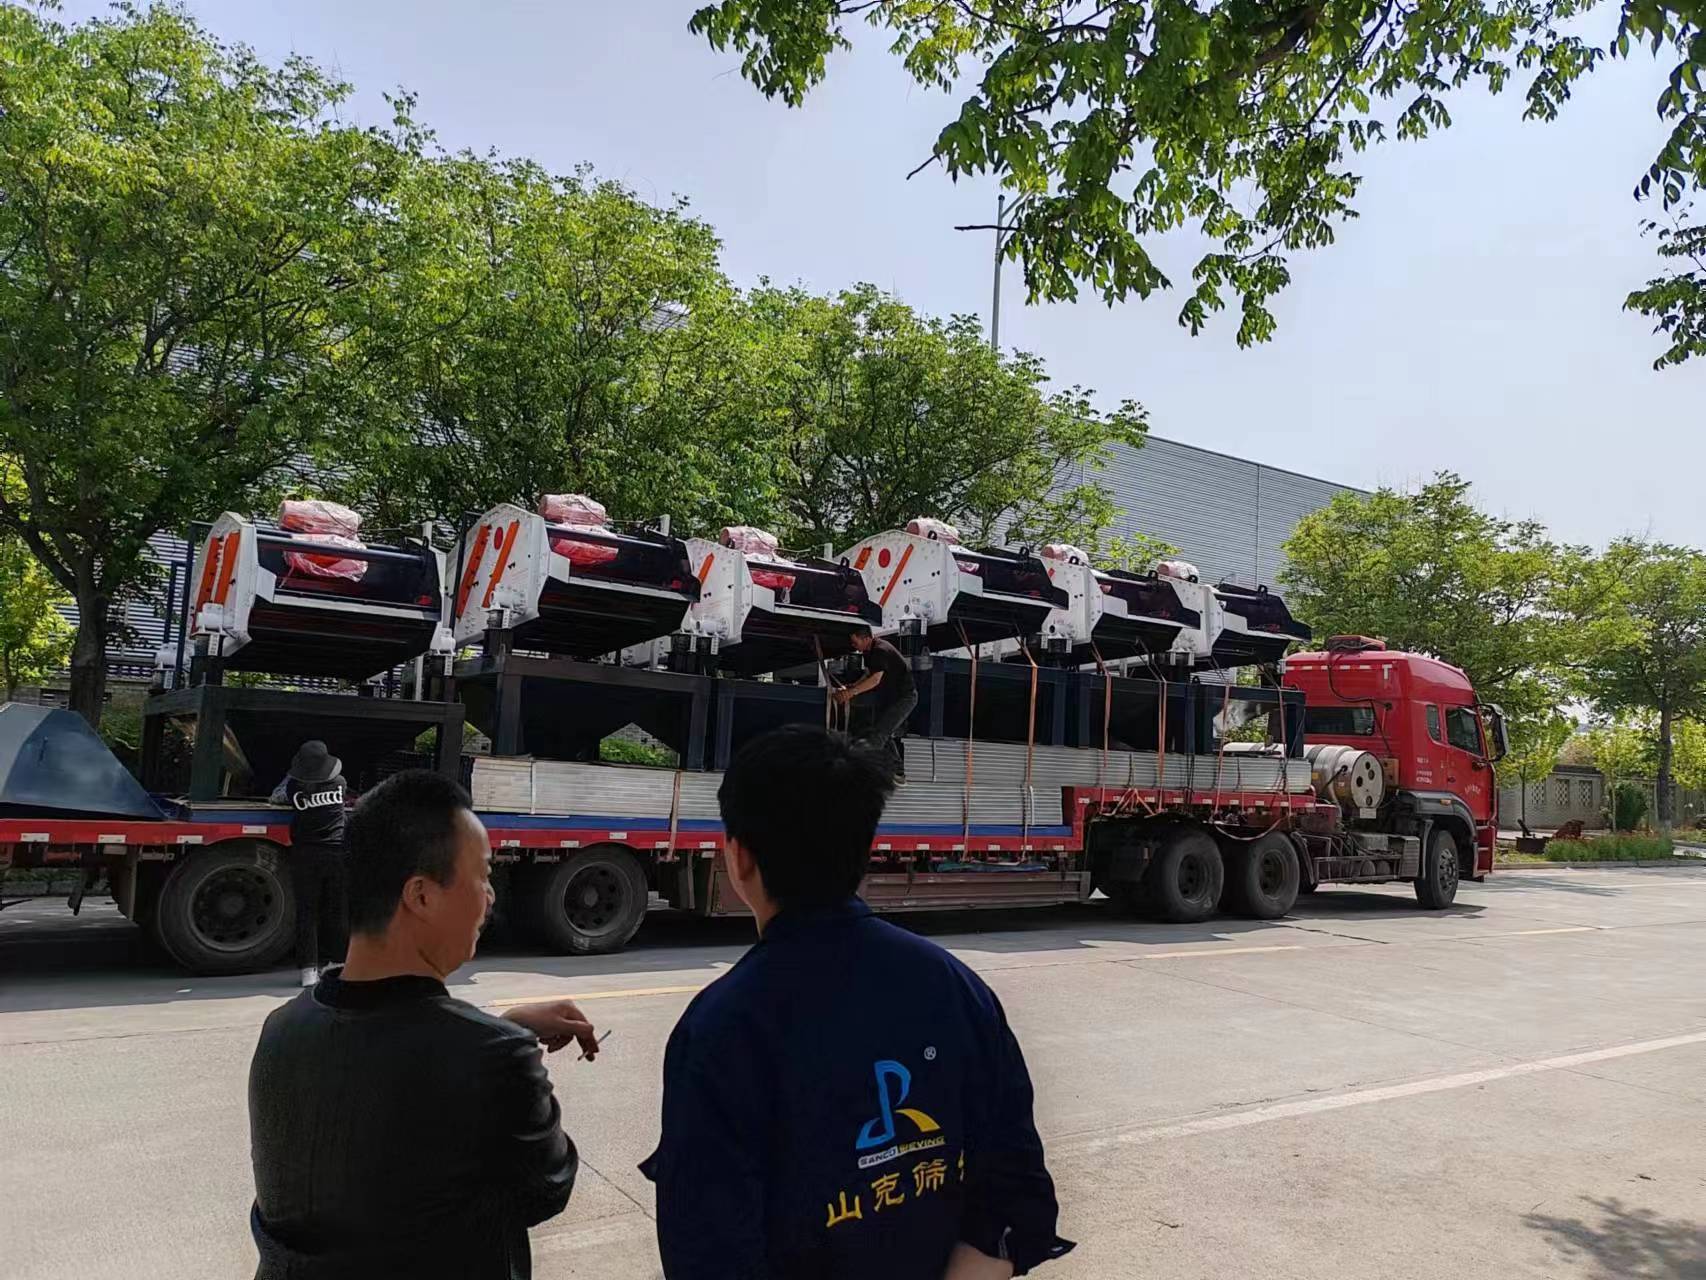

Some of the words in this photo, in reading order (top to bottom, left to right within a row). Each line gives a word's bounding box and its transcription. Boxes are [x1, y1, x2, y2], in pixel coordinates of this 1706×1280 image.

[859, 1147, 897, 1167] SANCO
[826, 1149, 965, 1228] 山克筛
